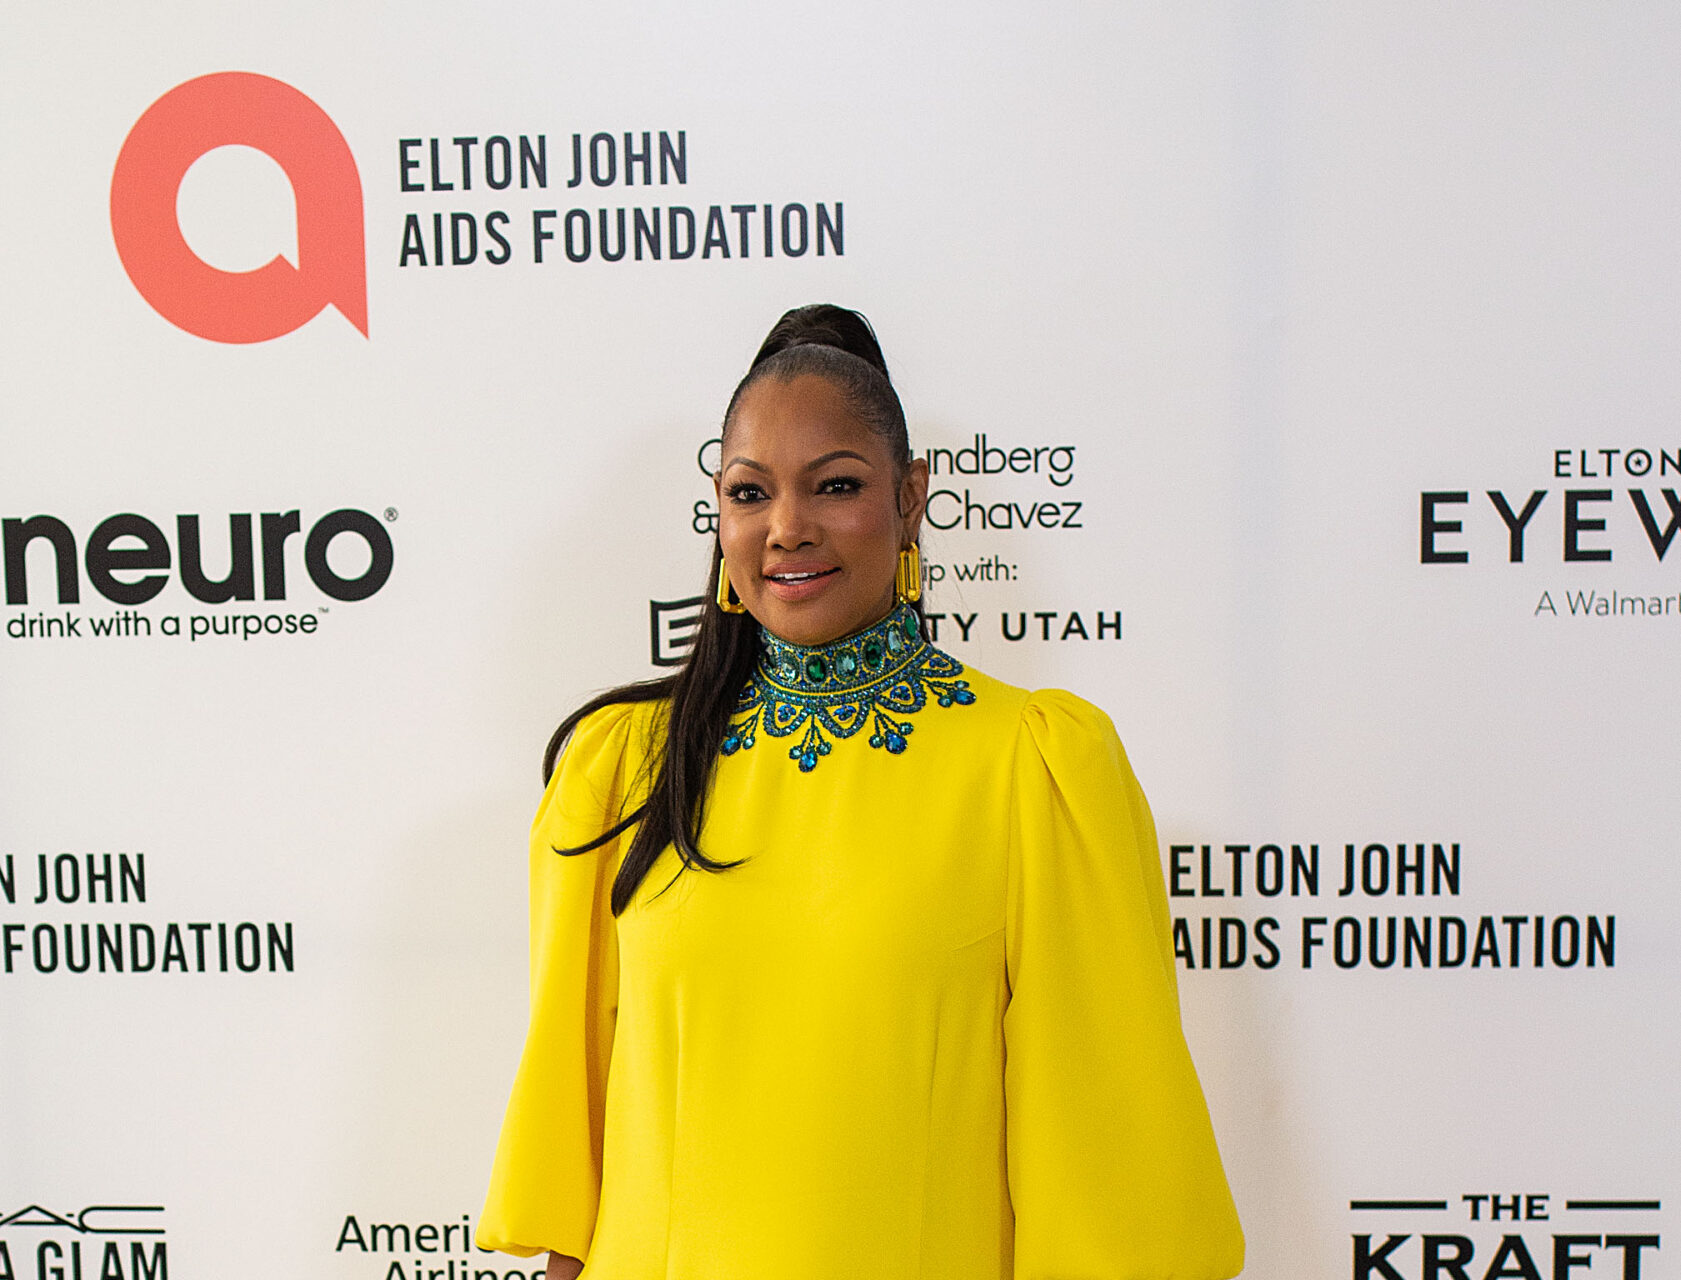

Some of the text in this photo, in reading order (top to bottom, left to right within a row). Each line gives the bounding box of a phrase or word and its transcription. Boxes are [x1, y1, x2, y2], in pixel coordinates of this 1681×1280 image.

[399, 131, 687, 192] ELTON JOHN
[399, 202, 844, 267] AIDS FOUNDATION
[1555, 448, 1681, 478] ELTON
[925, 489, 1082, 530] Chavez
[953, 555, 1018, 582] with:
[1535, 591, 1557, 616] A
[7, 612, 82, 639] drink
[89, 610, 151, 637] with
[160, 616, 180, 636] a
[1001, 611, 1121, 641] UTAH
[34, 853, 146, 904] JOHN
[1170, 843, 1460, 898] ELTON JOHN
[2, 922, 294, 974] FOUNDATION
[1173, 915, 1615, 970] AIDS FOUNDATION
[1462, 1194, 1549, 1221] THE
[336, 1215, 495, 1253] Ameri
